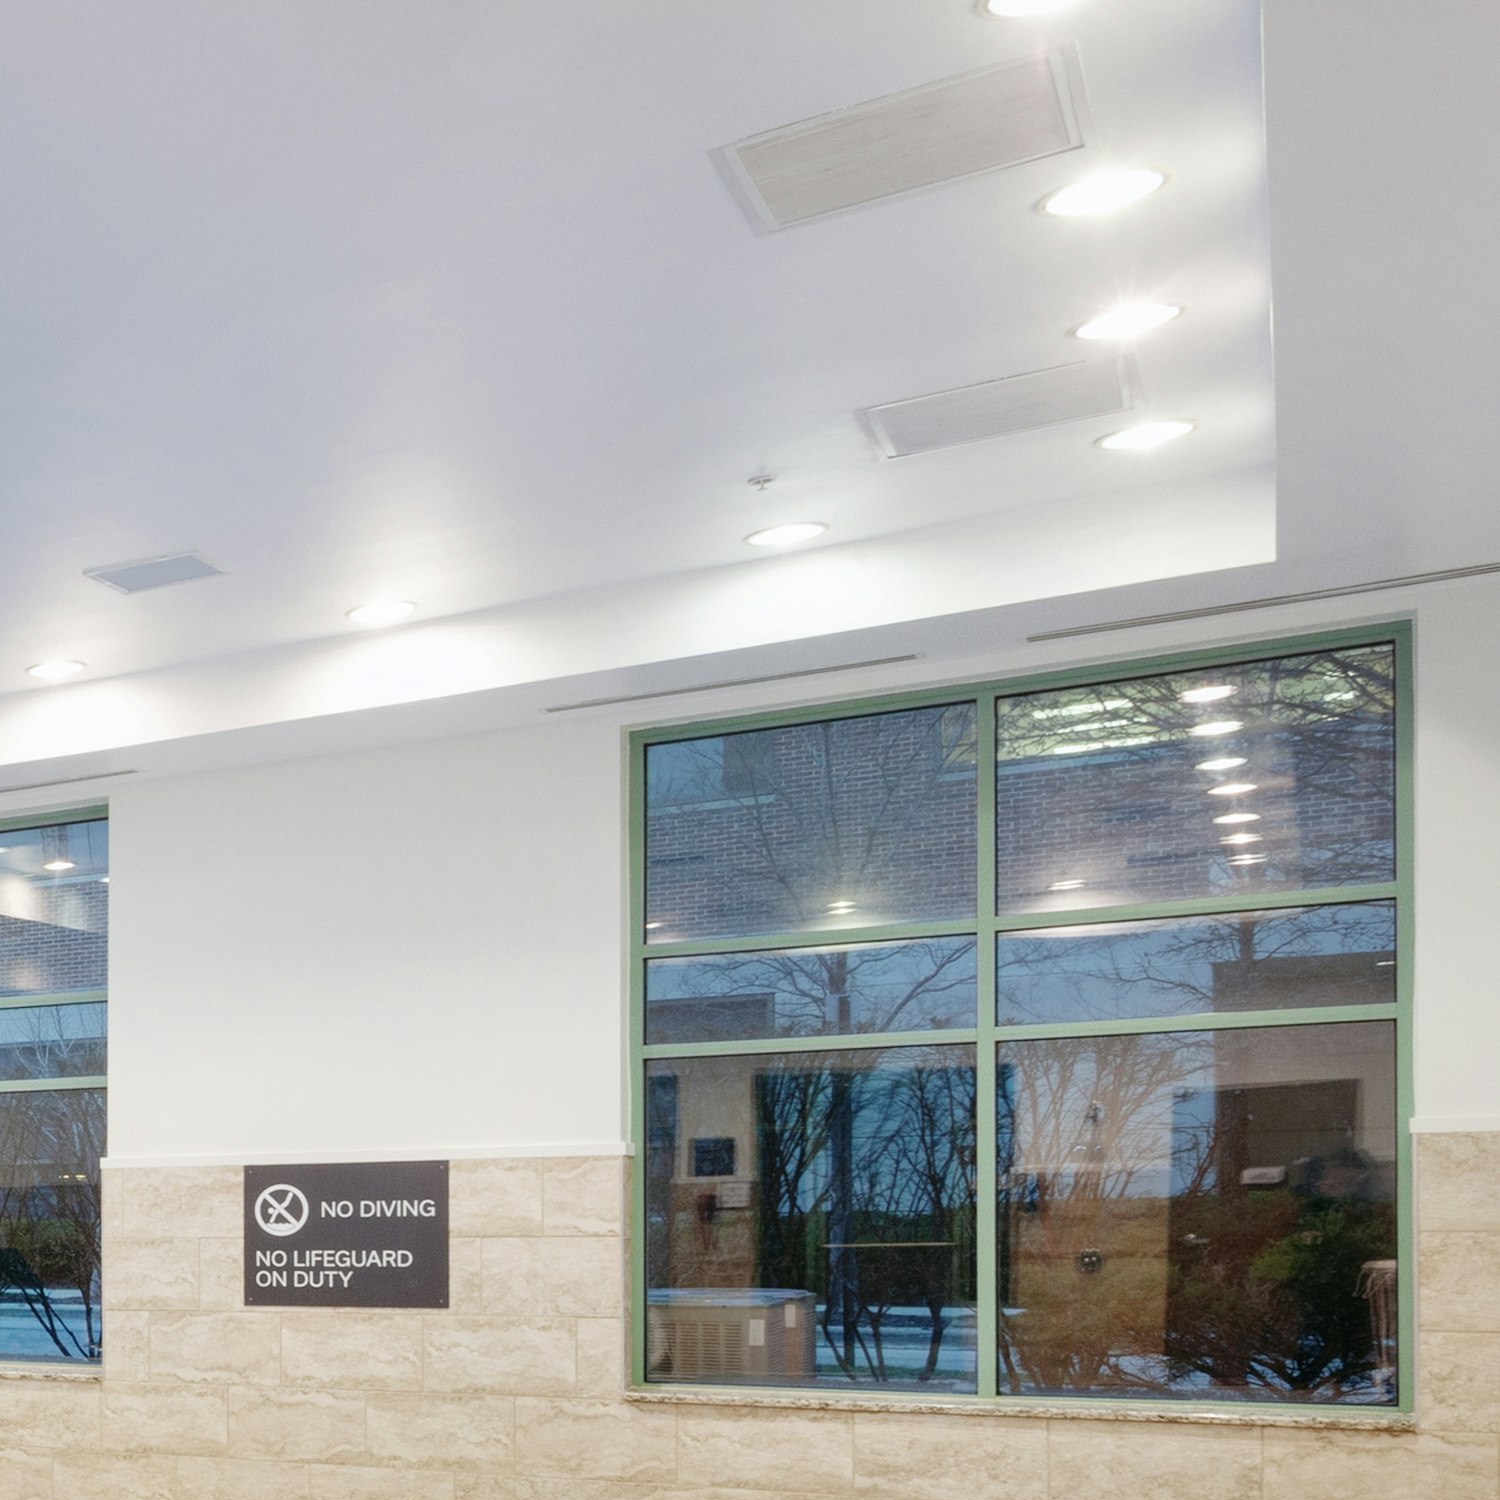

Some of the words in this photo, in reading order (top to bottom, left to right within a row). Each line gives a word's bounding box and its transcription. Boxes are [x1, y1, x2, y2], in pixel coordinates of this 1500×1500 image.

[321, 1201, 354, 1218] NO
[360, 1200, 436, 1218] DIVING
[256, 1250, 287, 1267] NO
[294, 1250, 413, 1267] LIFEGUARD
[256, 1271, 287, 1287] ON
[294, 1271, 354, 1288] DUTY
